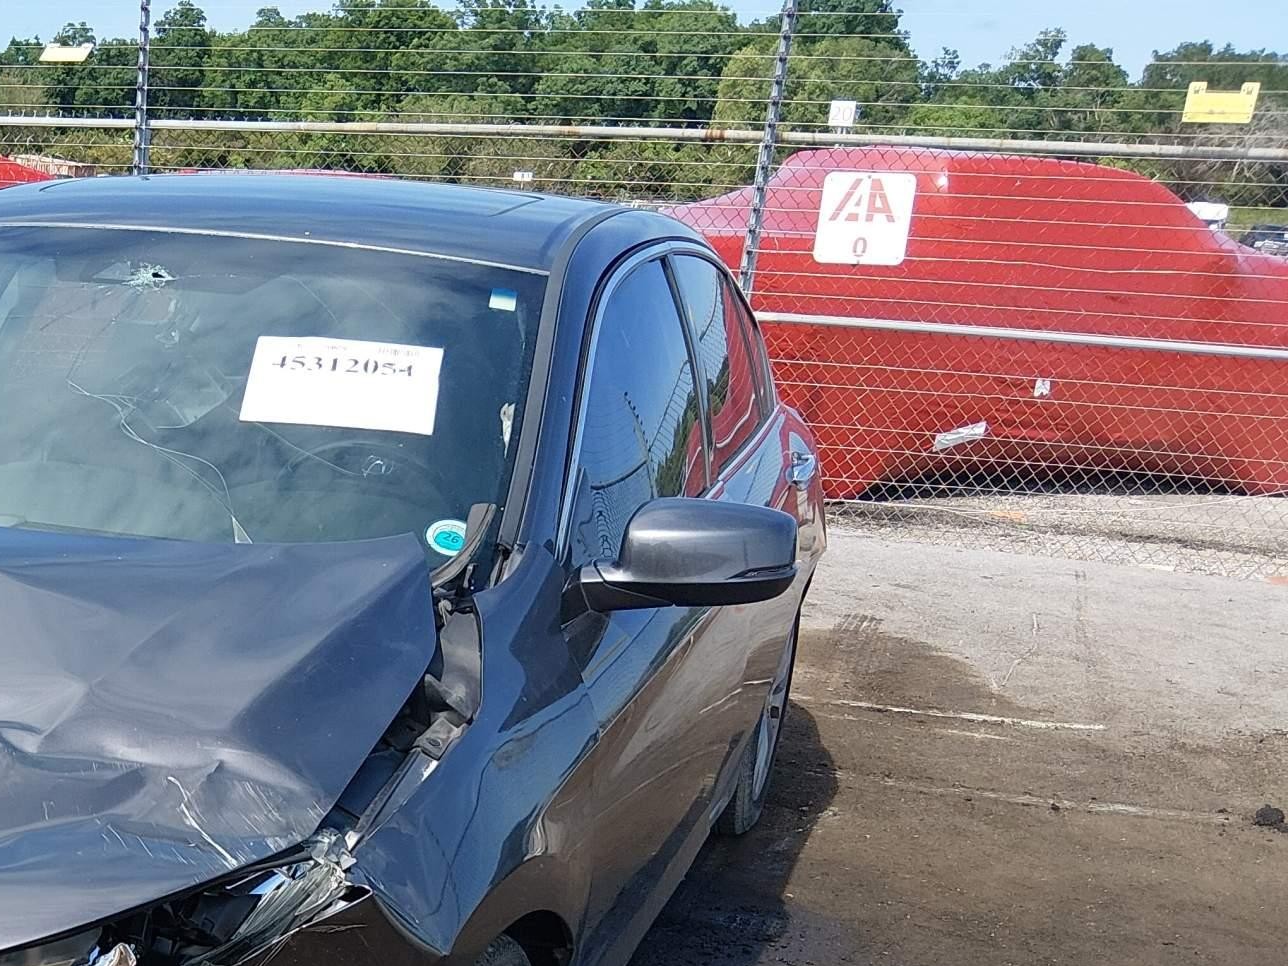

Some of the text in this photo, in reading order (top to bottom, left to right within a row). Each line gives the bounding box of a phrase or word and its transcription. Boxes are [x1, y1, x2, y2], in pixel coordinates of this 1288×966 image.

[831, 106, 853, 121] 20
[272, 355, 413, 377] 45312054
[442, 531, 460, 544] 26
